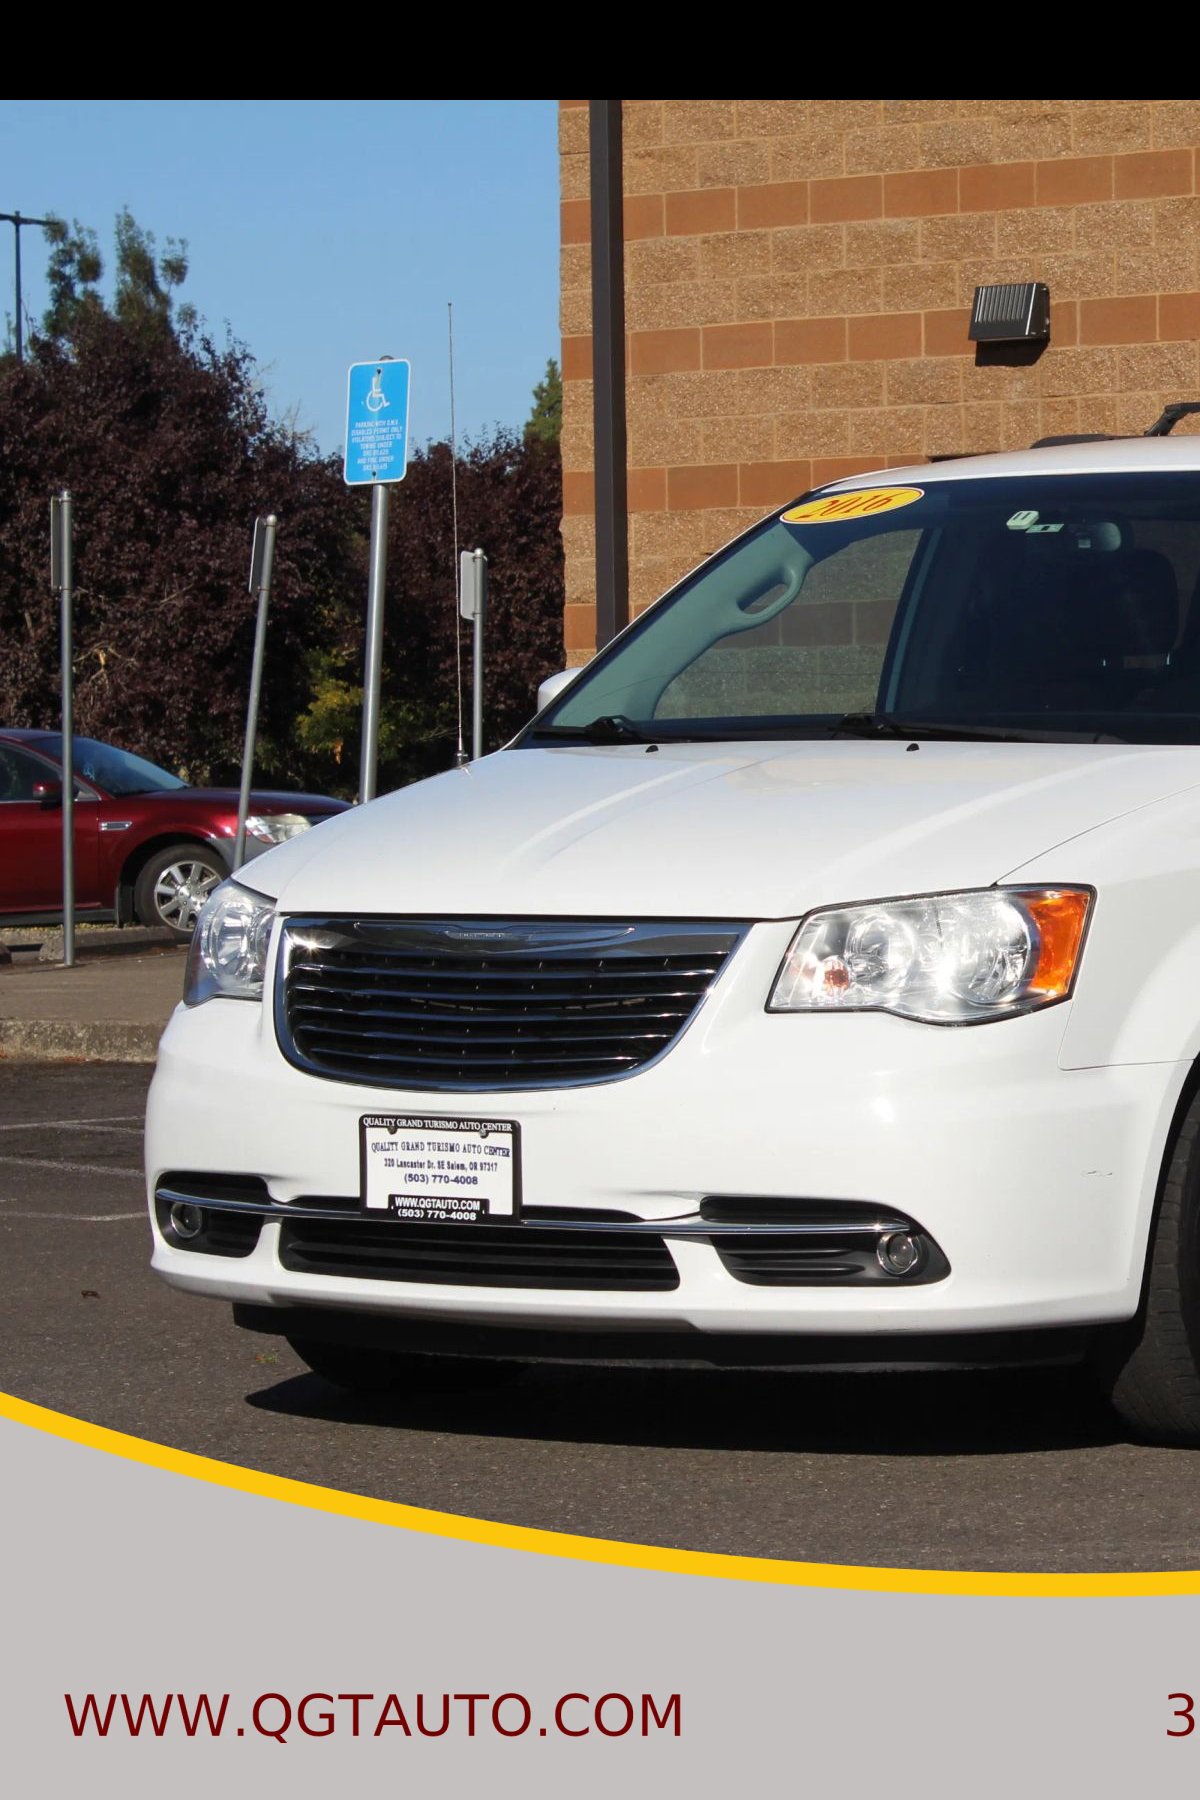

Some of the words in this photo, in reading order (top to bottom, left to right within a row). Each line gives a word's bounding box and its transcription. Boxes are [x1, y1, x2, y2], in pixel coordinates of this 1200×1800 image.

[794, 490, 910, 520] 2016
[363, 1117, 396, 1128] QUALITY
[396, 1118, 423, 1128] GRAND
[423, 1119, 458, 1130] TURISMO
[459, 1121, 480, 1131] AUTO
[481, 1122, 513, 1132] CENTER
[371, 1141, 399, 1153] QUALITY
[401, 1142, 425, 1152] GRAND
[427, 1143, 460, 1153] TURISMO
[462, 1144, 482, 1155] AUTO
[484, 1145, 511, 1158] CENTER
[384, 1158, 395, 1168] 320
[396, 1158, 426, 1169] Lancaster
[427, 1159, 436, 1169] Dr.
[437, 1160, 446, 1170] SE
[447, 1160, 468, 1172] Salem,
[469, 1162, 478, 1171] OR
[479, 1162, 498, 1172] 97317
[404, 1174, 429, 1185] (503)
[432, 1174, 478, 1185] 770-4008
[395, 1196, 480, 1211] WWW.QGTAUTO.COM
[397, 1209, 425, 1218] (503)
[427, 1210, 477, 1221] 770-4008
